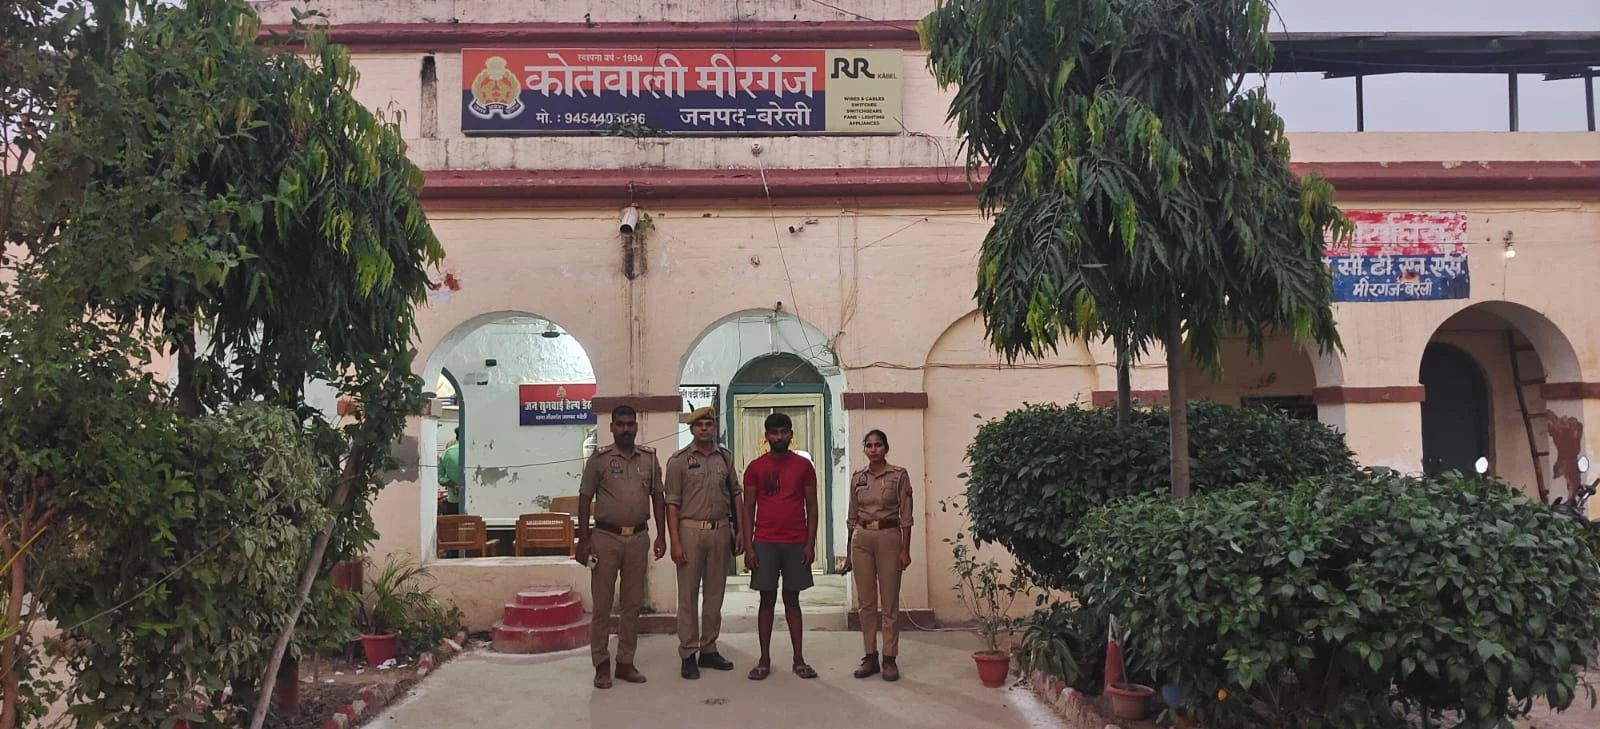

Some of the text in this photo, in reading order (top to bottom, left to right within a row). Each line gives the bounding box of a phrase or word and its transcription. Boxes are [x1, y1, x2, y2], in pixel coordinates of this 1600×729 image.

[622, 54, 643, 62] 1904
[524, 53, 817, 99] कोतवाली मीरगंज
[831, 58, 875, 78] RR
[536, 109, 552, 124] मो.
[679, 101, 812, 127] जनपद-बरेली
[524, 401, 538, 411] जन
[539, 398, 564, 413] सुनवाई
